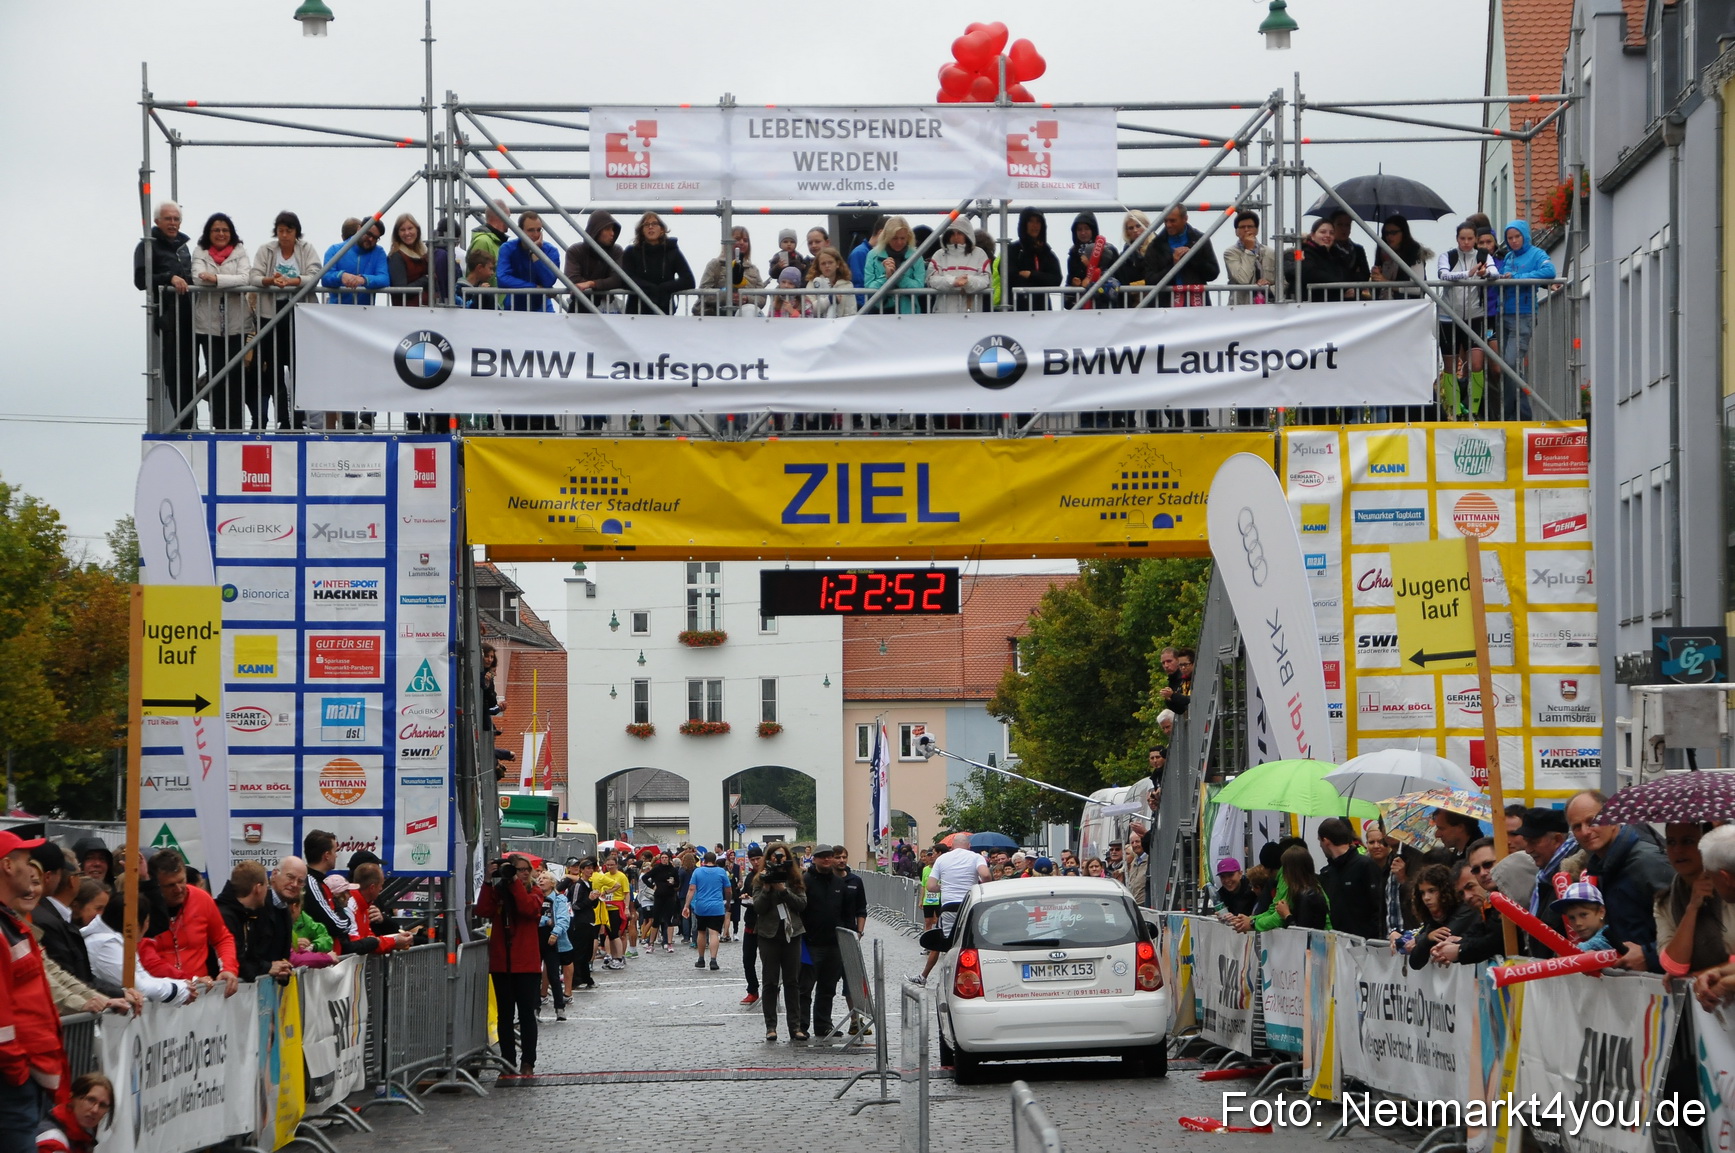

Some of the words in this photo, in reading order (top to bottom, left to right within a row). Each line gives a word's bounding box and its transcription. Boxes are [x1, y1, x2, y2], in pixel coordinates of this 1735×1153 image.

[748, 117, 943, 139] LEBENSSPENDER
[793, 151, 899, 172] WERDEN!
[608, 162, 648, 176] DKMS
[1009, 163, 1049, 176] DKMS
[616, 182, 638, 190] JEDER
[640, 182, 675, 190] EINZELNE
[677, 181, 700, 190] ZÄHLT
[797, 179, 895, 192] www.dkms.de
[1017, 181, 1039, 190] JEDER
[1078, 181, 1100, 190] ZÄHLT
[400, 331, 450, 353] BMW
[972, 336, 1023, 356] BMW
[1043, 345, 1147, 376] BMW
[1157, 341, 1338, 379] Laufsport
[470, 347, 576, 378] BMW
[587, 352, 769, 387] Laufsport
[1456, 434, 1489, 456] RUND
[1534, 437, 1553, 446] GUT
[1555, 435, 1573, 445] FÜR
[1575, 435, 1588, 445] SIE
[1292, 442, 1334, 456] Xplus1
[1370, 463, 1406, 474] KANN
[1455, 455, 1494, 475] SCHAU
[242, 470, 270, 483] Braun
[414, 469, 435, 481] Braun
[781, 462, 960, 525] ZIEL
[1059, 492, 1154, 508] Neumarkter
[507, 496, 602, 512] Neumarkter
[606, 497, 681, 513] Stadtlauf
[1357, 512, 1394, 520] Neumarkter
[1396, 510, 1422, 521] Tagblatt
[1453, 513, 1500, 521] WITTMANN
[312, 522, 378, 542] Xplus1
[1303, 523, 1327, 531] KANN
[1554, 520, 1578, 532] DEHN
[1306, 555, 1325, 566] maxi
[323, 579, 379, 588] INTERSPORT
[1531, 568, 1594, 588] Xplus1
[242, 589, 290, 599] Bionorica
[313, 589, 378, 600] HACKNER
[820, 573, 946, 610] 1:22:52
[1421, 597, 1459, 620] lauf
[315, 640, 335, 649] GUT
[337, 638, 354, 649] FÜR
[356, 640, 374, 649] SIE!
[158, 645, 197, 665] lauf
[237, 664, 274, 674] KANN
[326, 701, 362, 720] maxi
[1407, 702, 1433, 711] BÖGL
[1547, 704, 1591, 712] Neumarkter
[1539, 712, 1597, 723] Lammsbräu
[346, 728, 360, 739] dsl
[401, 747, 430, 757] swn
[266, 782, 292, 791] BÖGL
[319, 779, 367, 787] WITTMANN
[1030, 965, 1046, 976] NM
[1053, 964, 1069, 976] RK
[1072, 963, 1093, 975] 153
[1504, 962, 1543, 979] Audi
[1546, 955, 1580, 971] BKK
